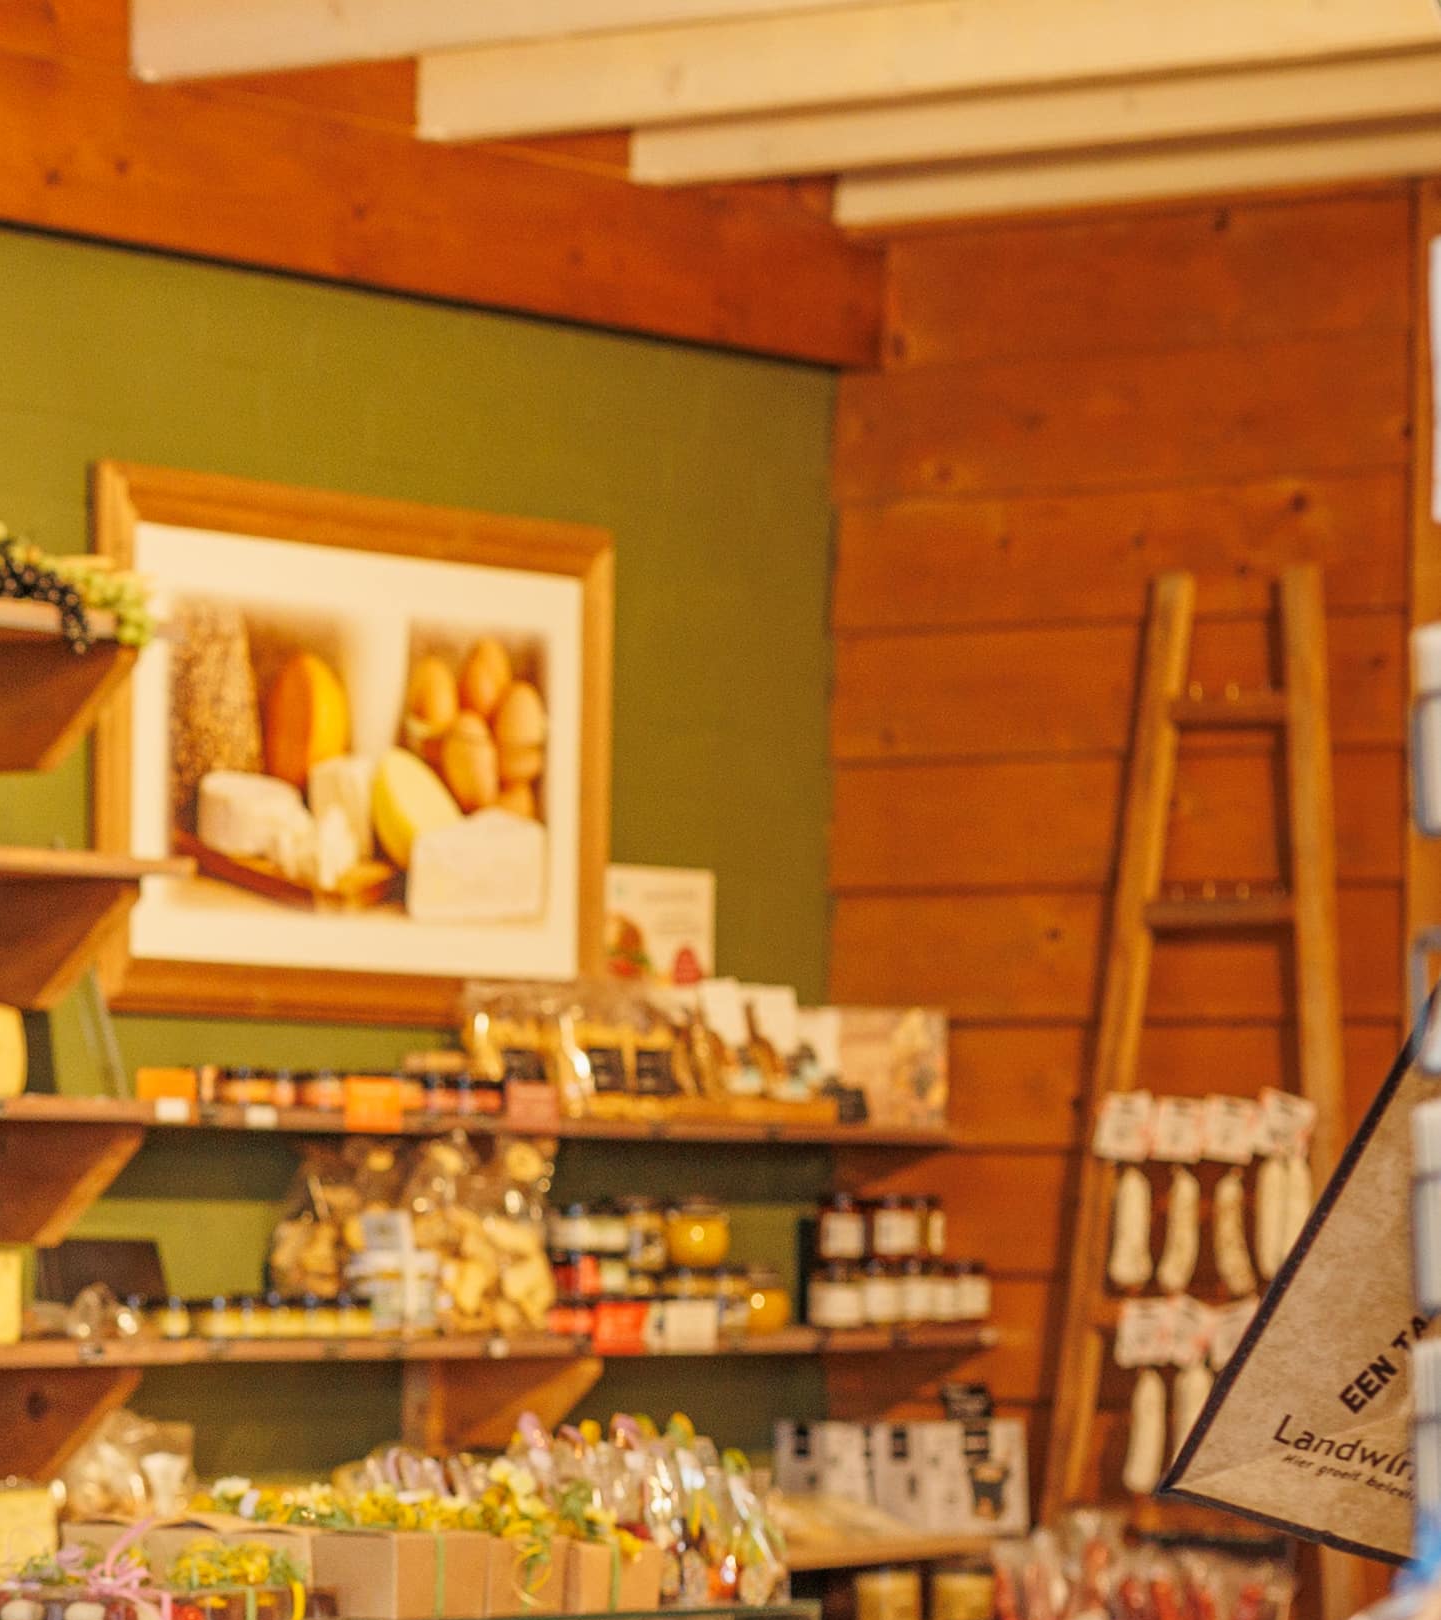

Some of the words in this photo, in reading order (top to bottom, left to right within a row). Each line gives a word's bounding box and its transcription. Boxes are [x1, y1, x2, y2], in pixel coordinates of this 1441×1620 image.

[1338, 1354, 1399, 1415] EEN
[1391, 1316, 1429, 1351] TA
[1272, 1413, 1416, 1482] Landwin
[1281, 1453, 1314, 1470] Hier
[1315, 1464, 1362, 1482] groeit
